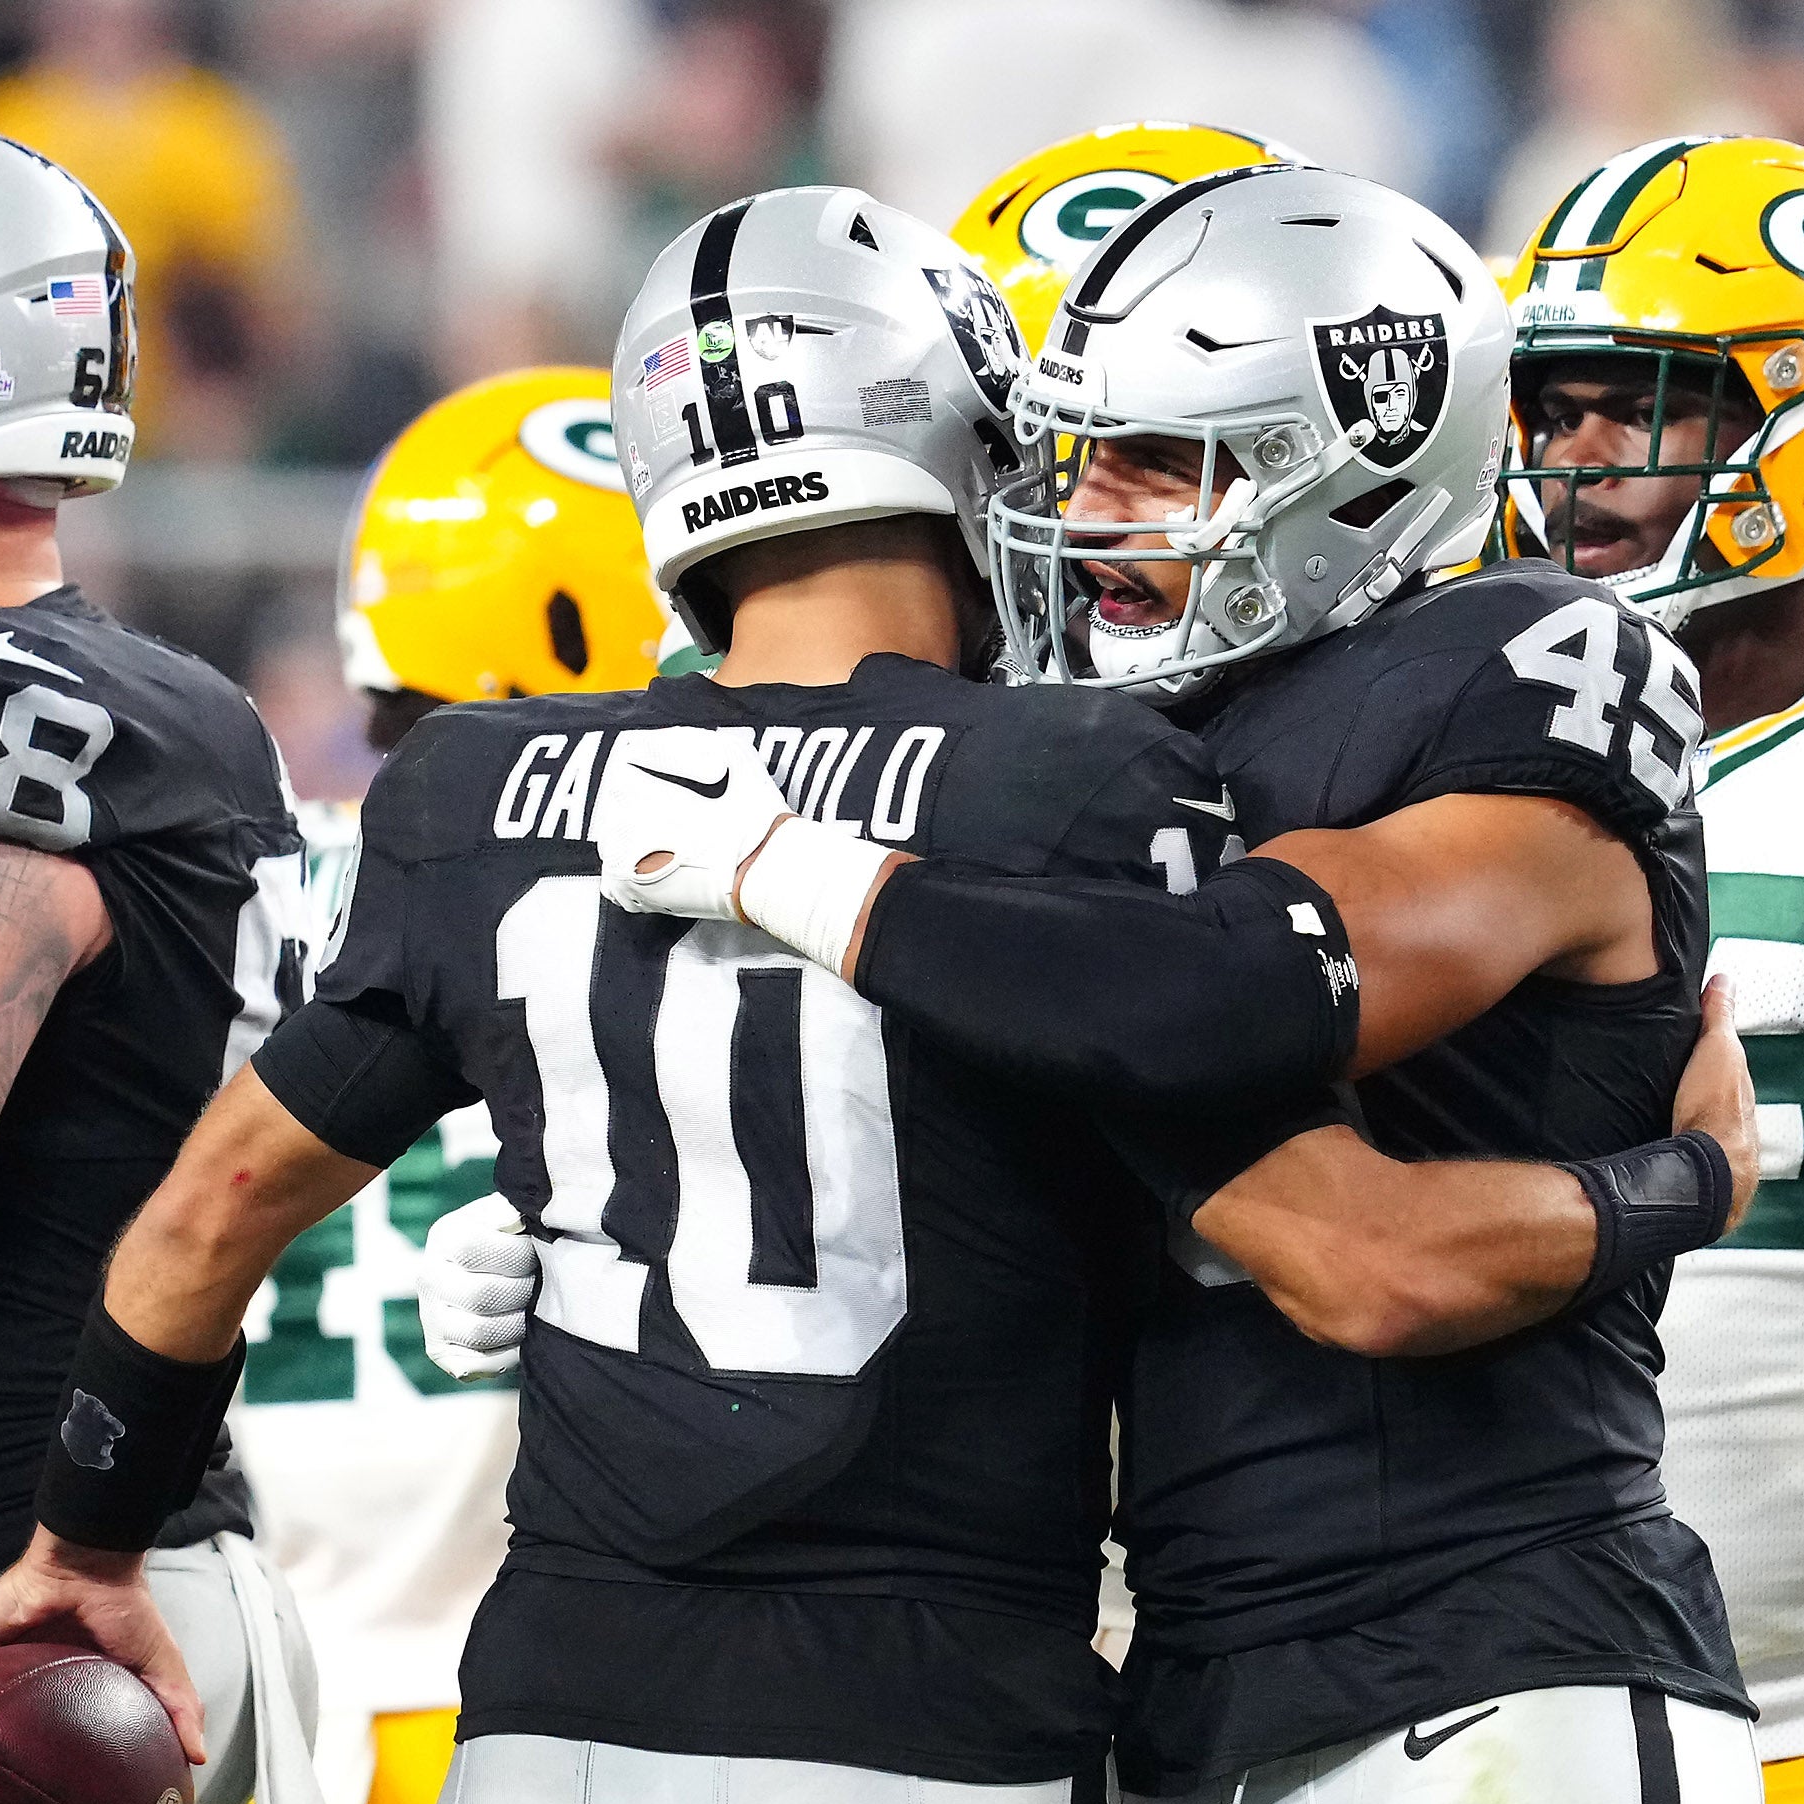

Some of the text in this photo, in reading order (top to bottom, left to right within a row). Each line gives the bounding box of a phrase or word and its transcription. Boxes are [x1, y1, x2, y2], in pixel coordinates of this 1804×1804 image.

[1329, 318, 1435, 347] RAIDERS
[1039, 357, 1084, 386] RAIDERS
[682, 380, 805, 467] 10
[682, 471, 829, 534] RAIDERS
[1501, 598, 1708, 818] 45
[495, 873, 909, 1378] 10
